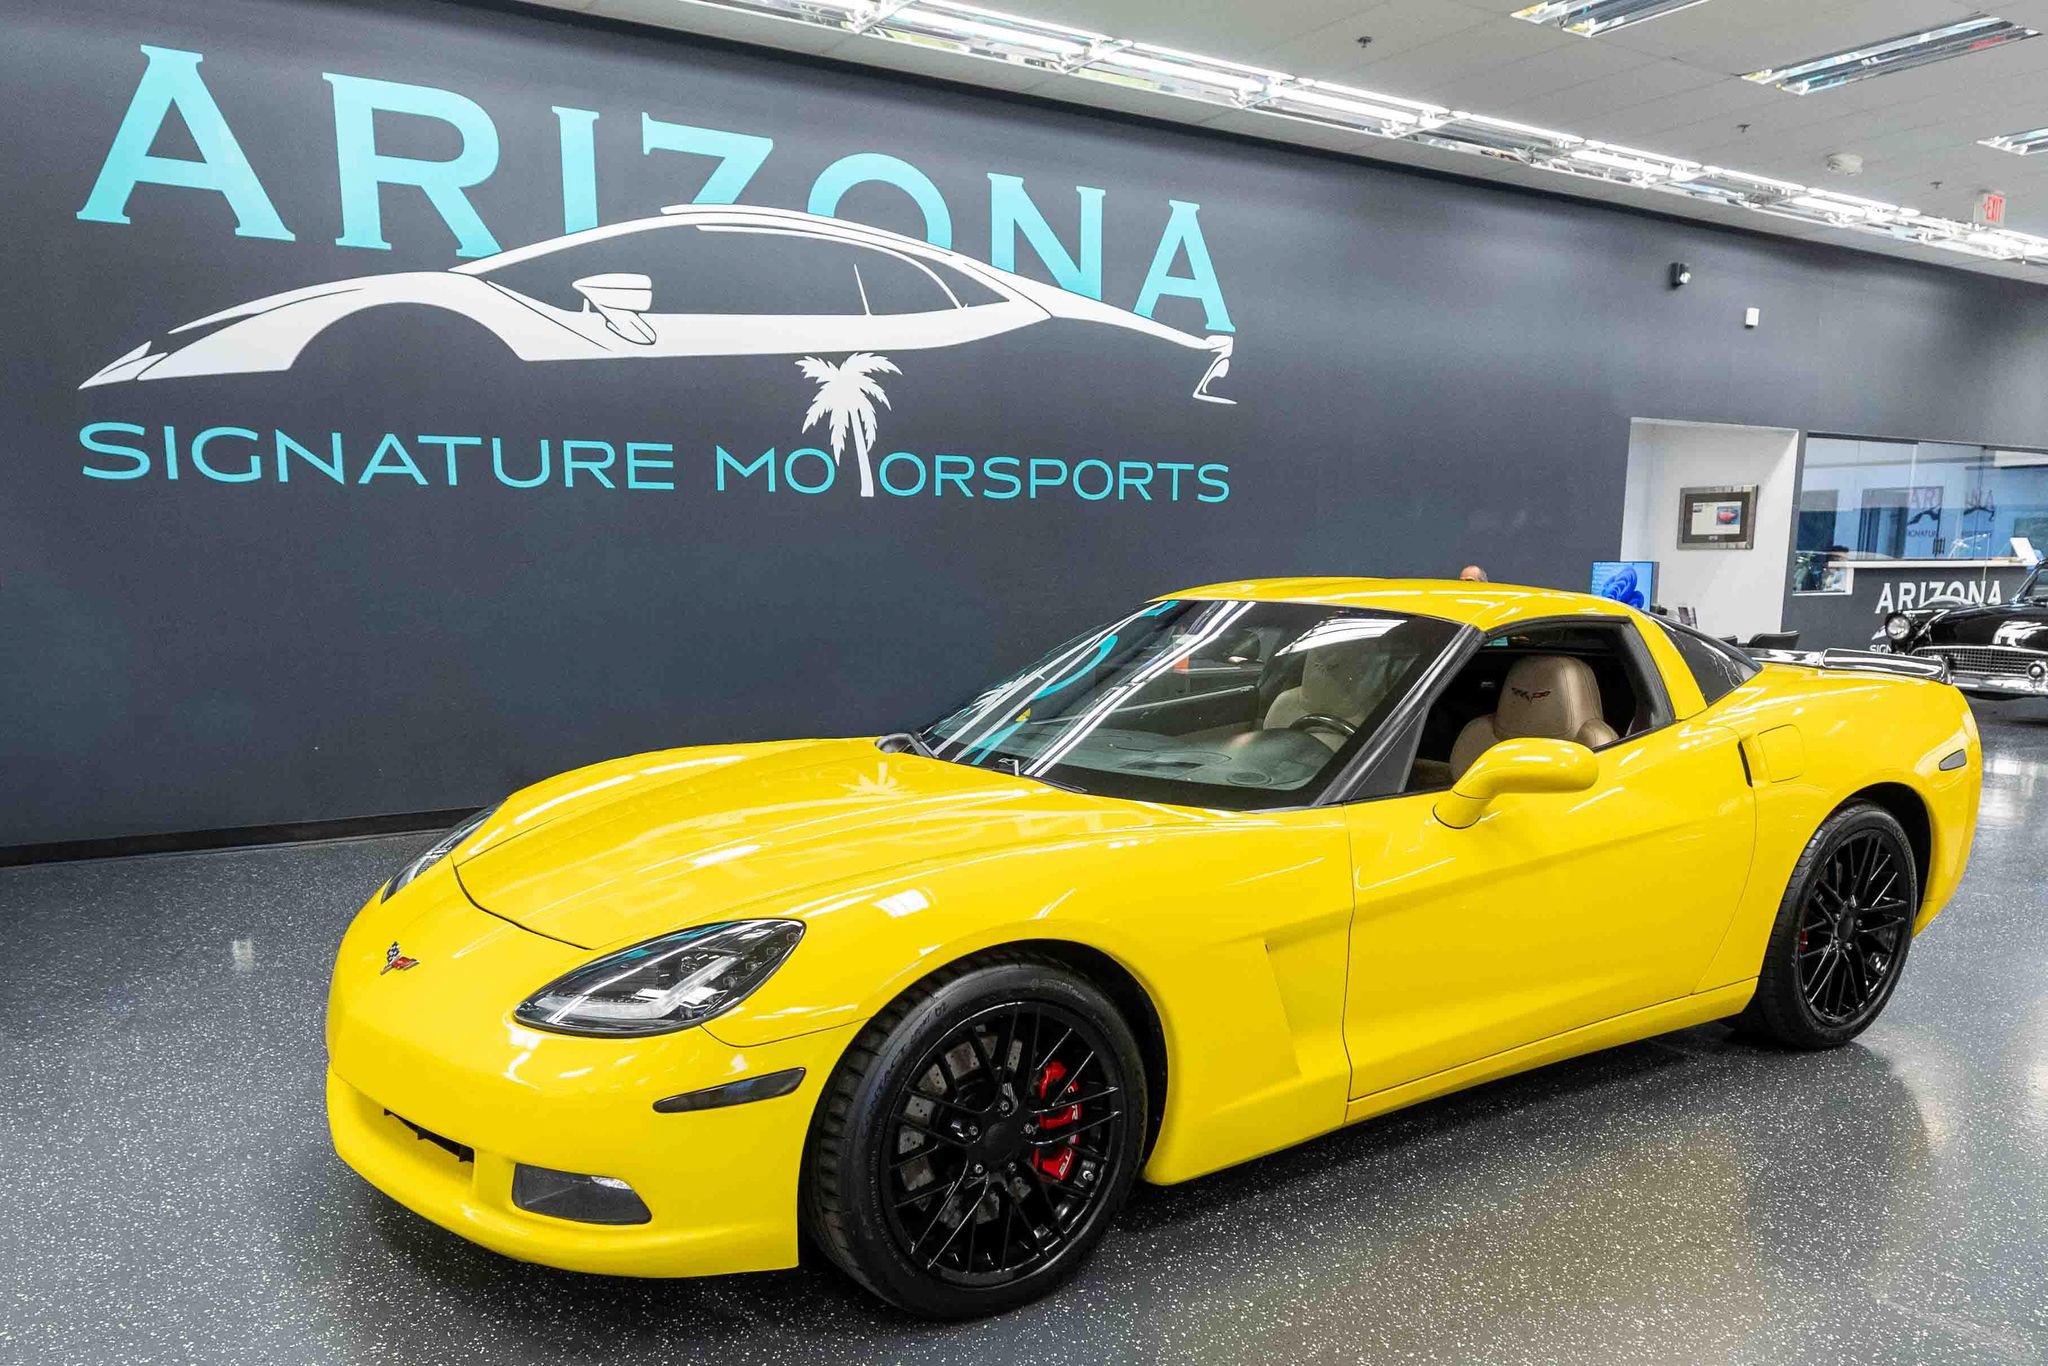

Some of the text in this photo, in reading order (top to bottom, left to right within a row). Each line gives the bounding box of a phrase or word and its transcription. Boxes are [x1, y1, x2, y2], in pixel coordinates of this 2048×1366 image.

[76, 43, 1236, 334] ARIZONA
[80, 421, 676, 491] SIGNATURE
[1874, 580, 2002, 614] ARIZONA
